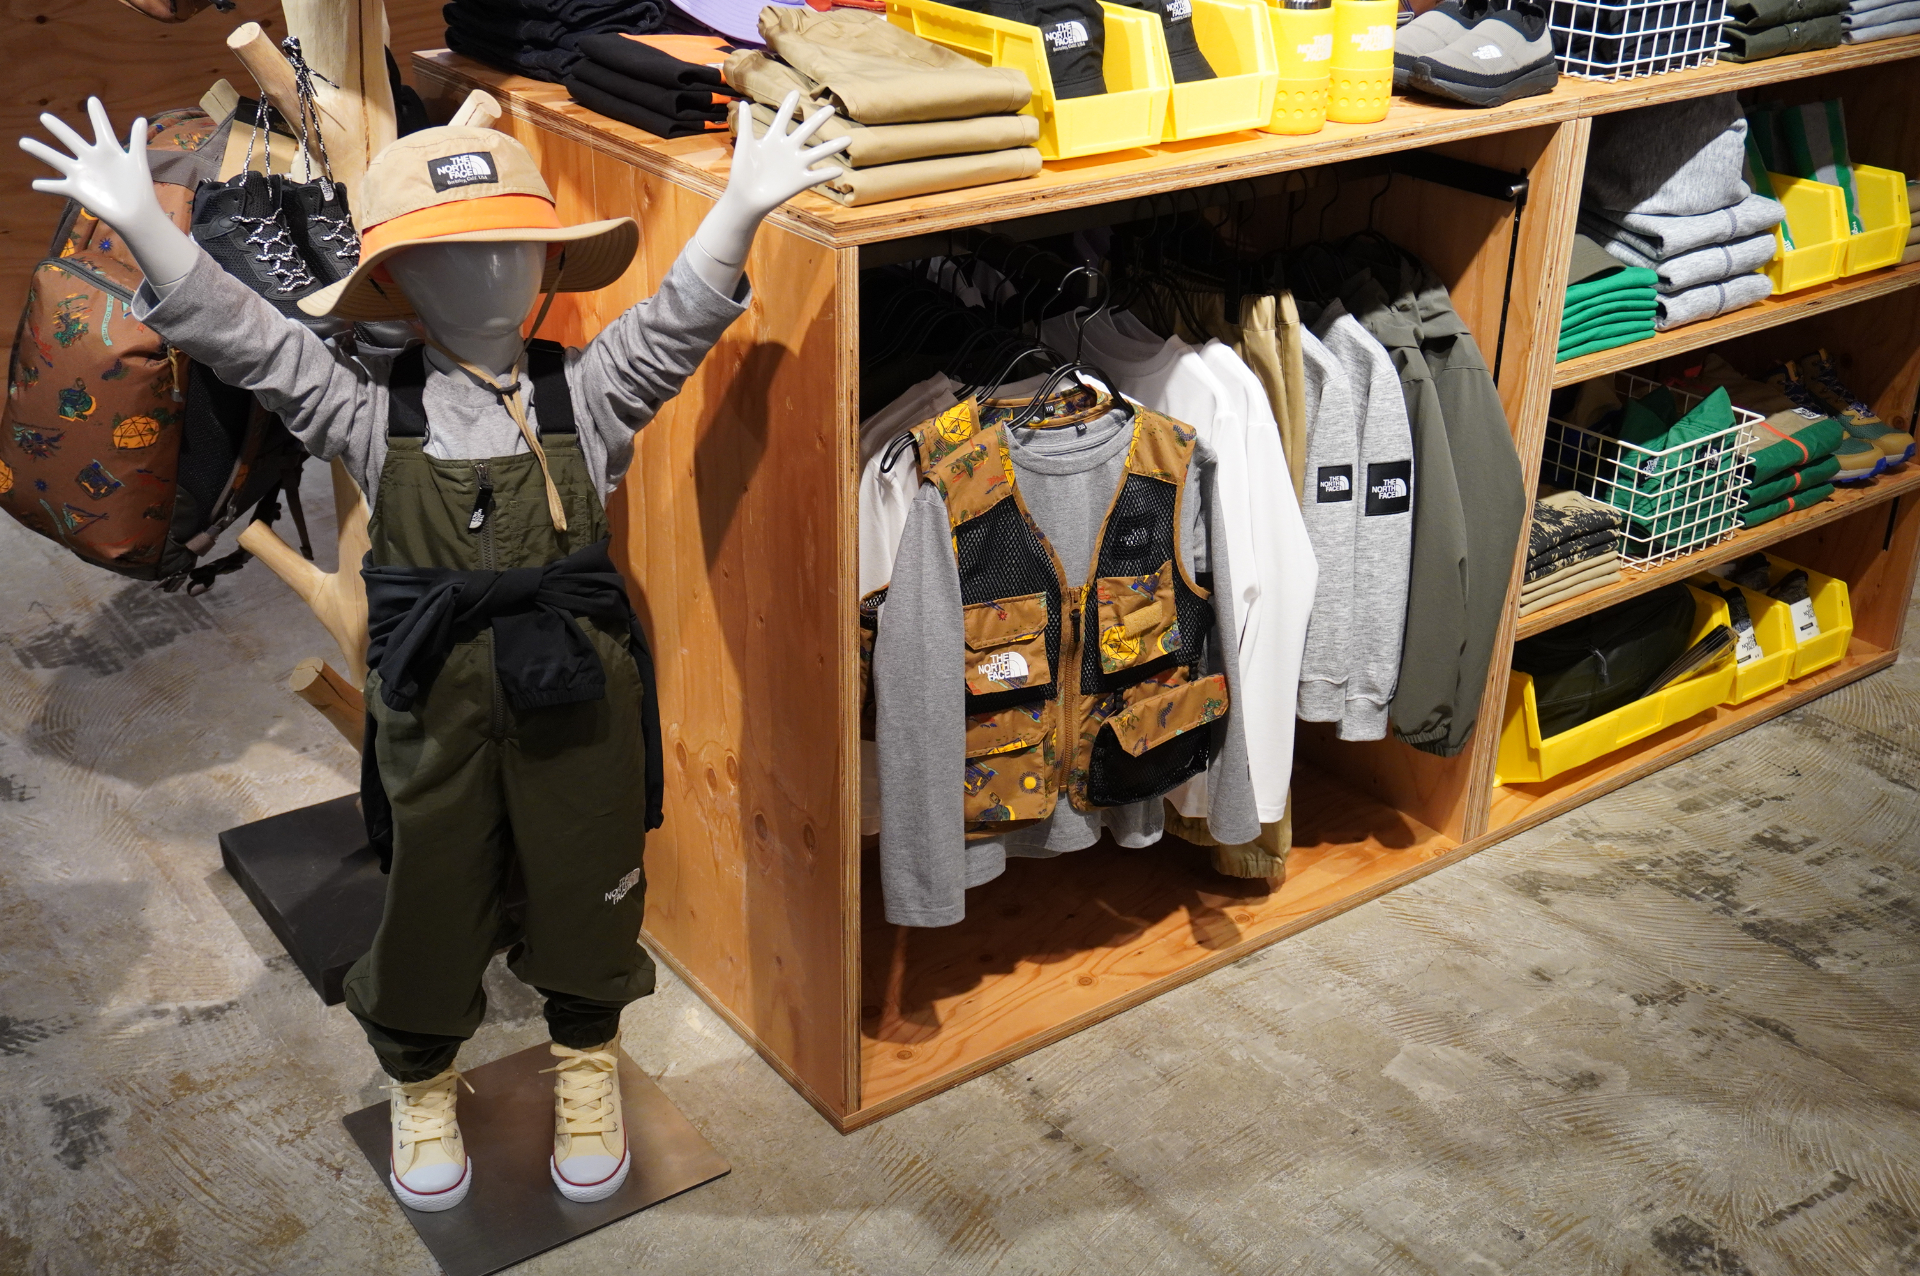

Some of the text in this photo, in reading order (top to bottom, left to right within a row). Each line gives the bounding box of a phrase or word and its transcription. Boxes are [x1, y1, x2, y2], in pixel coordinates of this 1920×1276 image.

[1056, 22, 1072, 31] THE
[1045, 28, 1073, 41] NORTH
[1055, 38, 1073, 46] FACE
[450, 155, 470, 165] THE
[437, 161, 472, 175] NORTH
[449, 169, 473, 179] FACE
[1371, 485, 1396, 493] NORTH
[1379, 491, 1396, 499] FACE
[990, 652, 1009, 664] THE
[978, 660, 1010, 674] NORTH
[988, 670, 1010, 681] FACE
